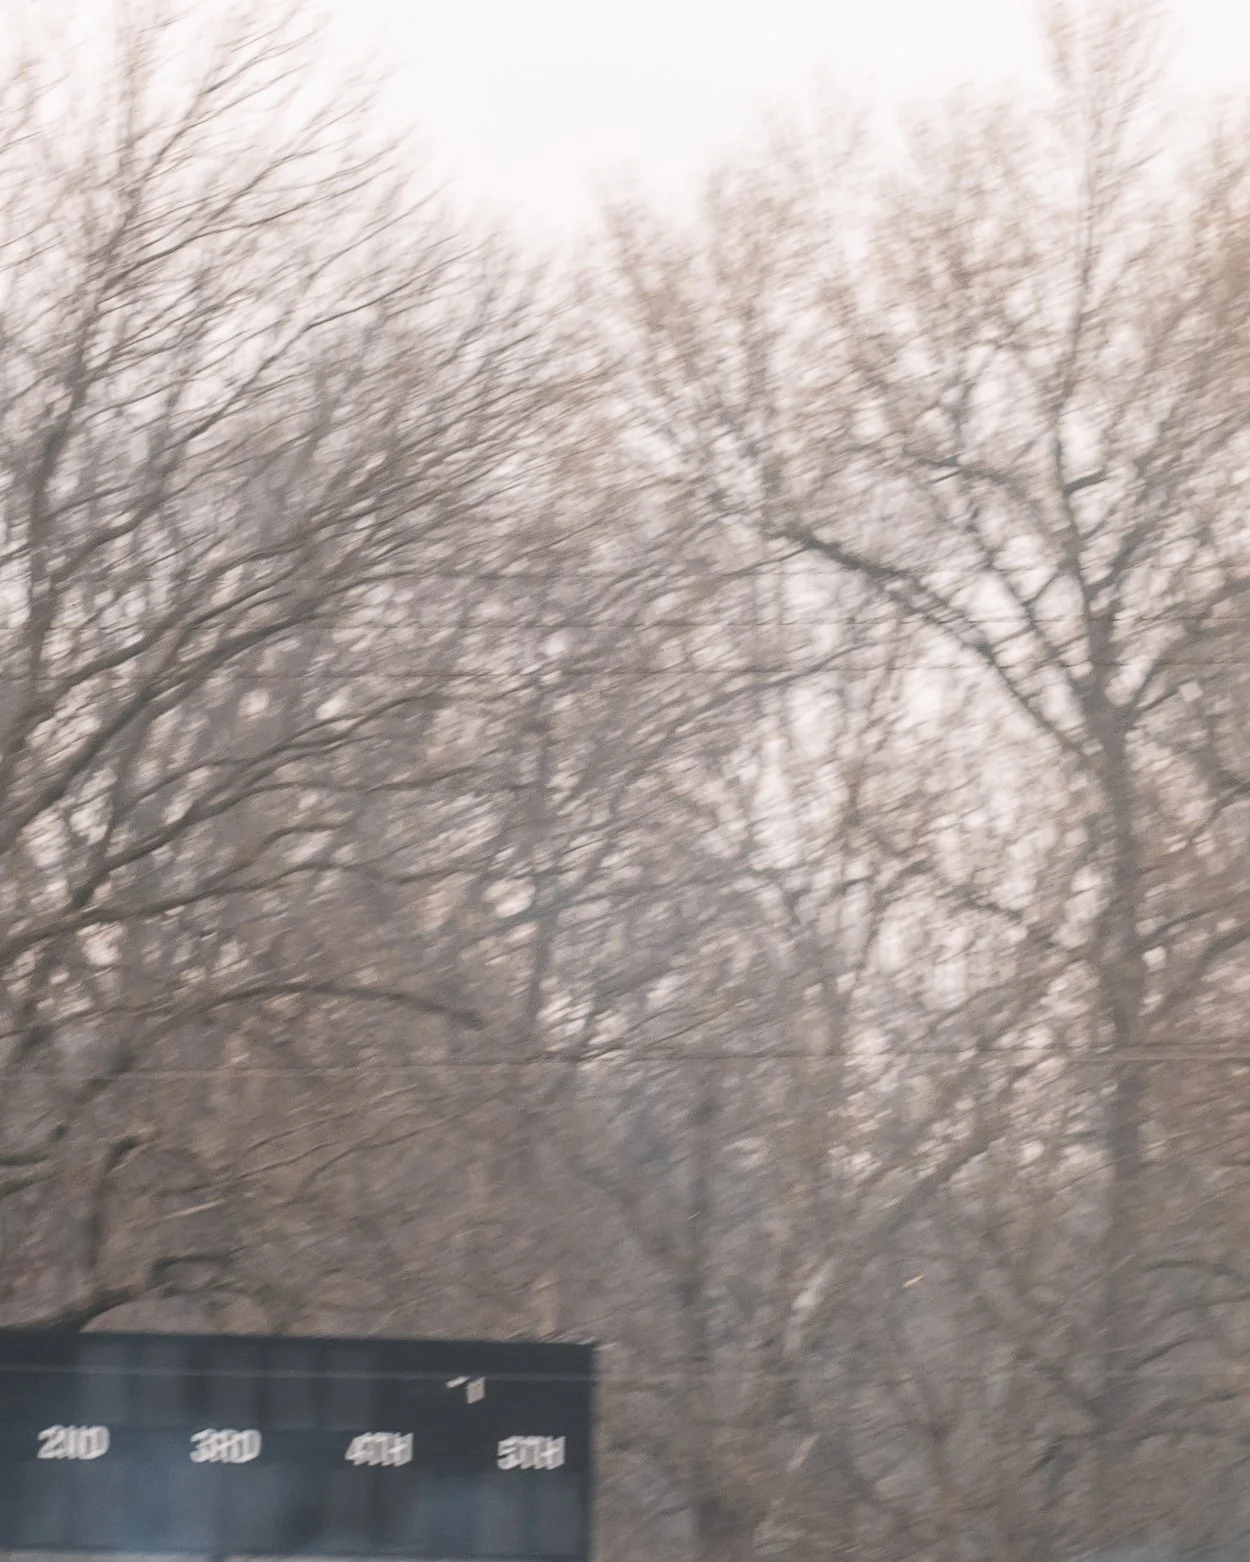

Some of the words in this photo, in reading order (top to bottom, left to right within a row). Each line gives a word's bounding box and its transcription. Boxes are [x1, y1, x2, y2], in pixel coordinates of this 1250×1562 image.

[37, 1425, 110, 1460] 2ND
[190, 1428, 262, 1464] 3RD
[345, 1432, 414, 1467] 4TH
[497, 1436, 566, 1470] 5TH
